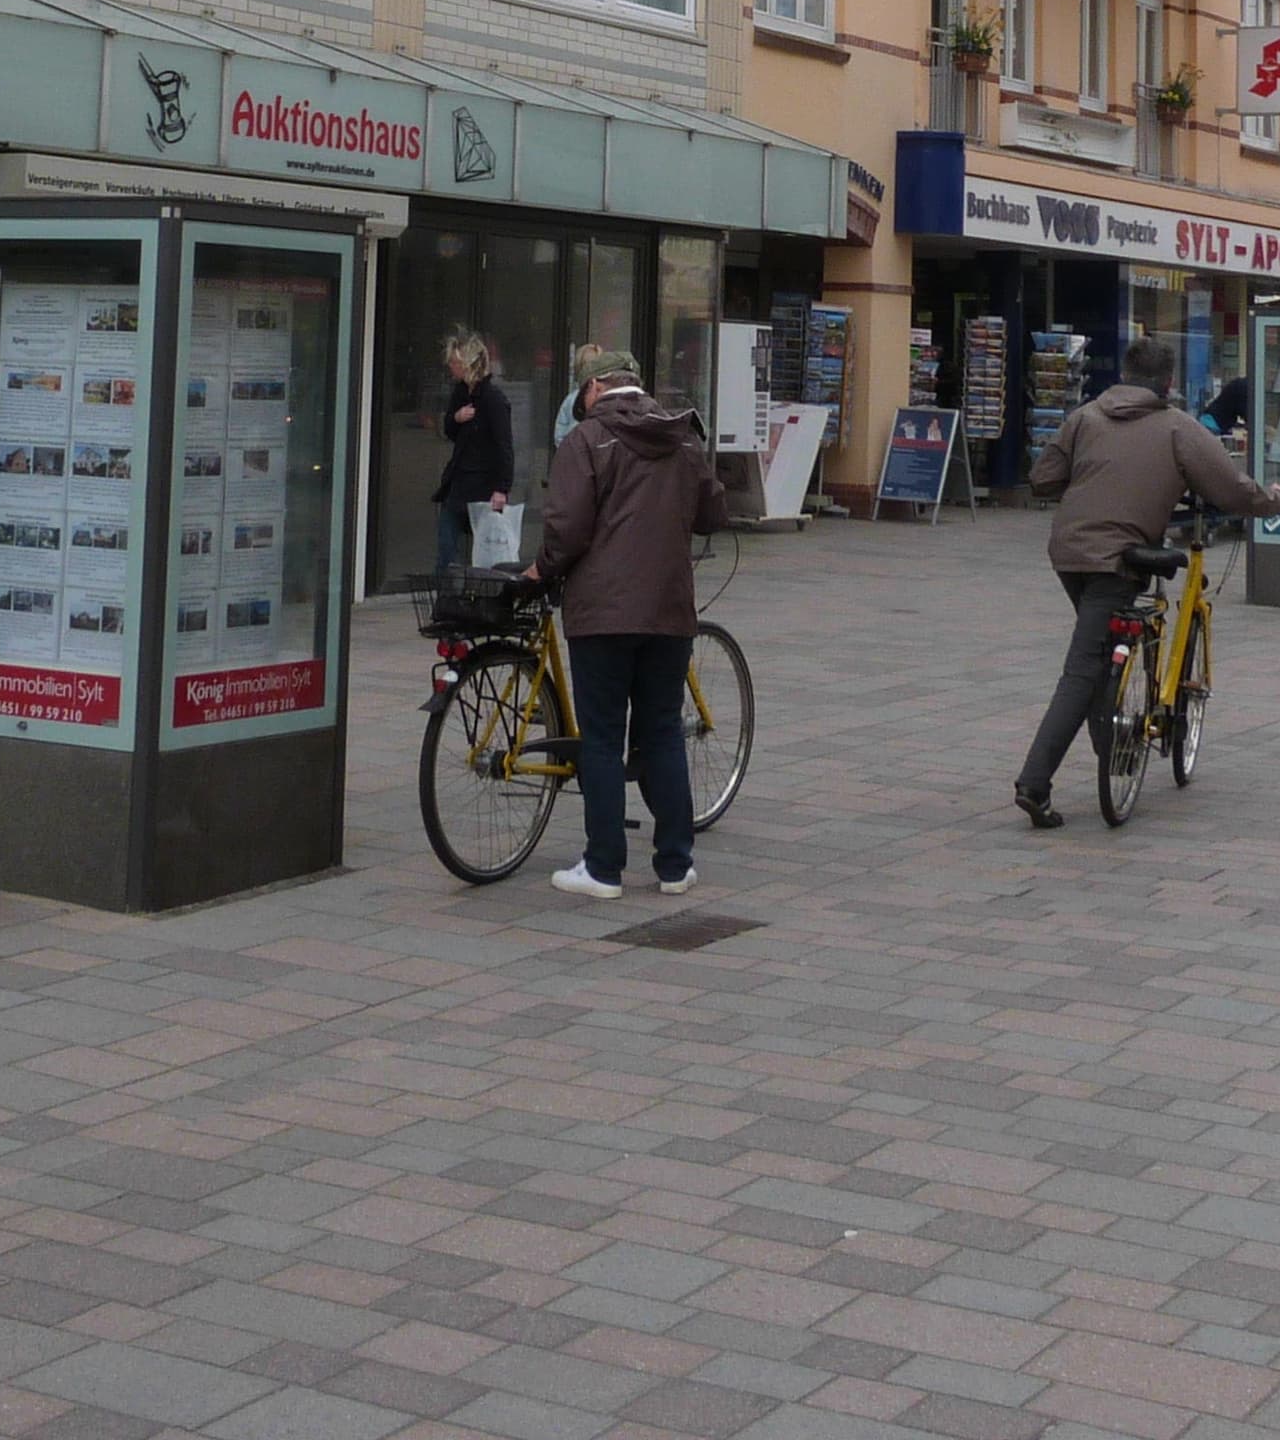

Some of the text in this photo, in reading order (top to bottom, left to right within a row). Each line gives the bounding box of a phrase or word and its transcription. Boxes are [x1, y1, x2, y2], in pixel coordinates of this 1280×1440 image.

[231, 89, 421, 160] Auktionshaus
[27, 172, 101, 193] Versteigerungen
[286, 159, 376, 178] www.sylterauktionen.de
[966, 191, 1158, 246] Buchhaus VOSS Papeterie
[1175, 220, 1230, 264] SYLT
[77, 679, 106, 708] Sylt
[186, 666, 312, 706] König Immobilien Sylt
[29, 704, 45, 718] 99
[45, 706, 61, 721] 59
[61, 708, 83, 723] 210
[203, 709, 219, 722] Tel.
[219, 704, 247, 720] 04651
